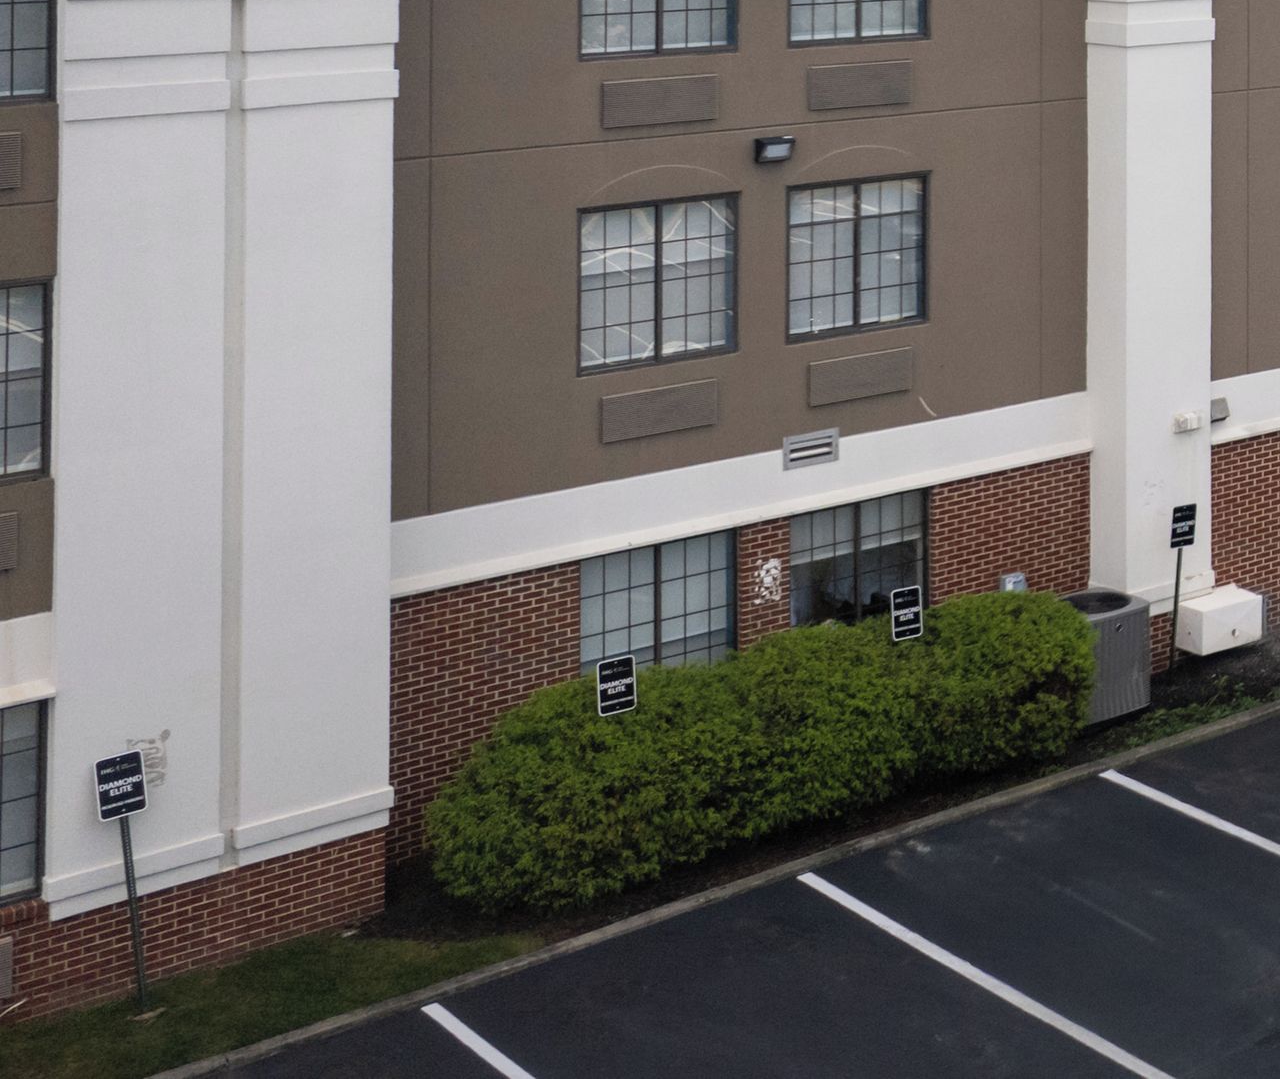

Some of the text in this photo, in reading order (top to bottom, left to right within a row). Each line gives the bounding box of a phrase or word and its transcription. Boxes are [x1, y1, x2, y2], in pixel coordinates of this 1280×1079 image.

[599, 676, 634, 691] DIAMOND
[607, 684, 627, 695] ELITE
[99, 774, 143, 792] DIAMOND
[109, 783, 134, 797] ELITE
